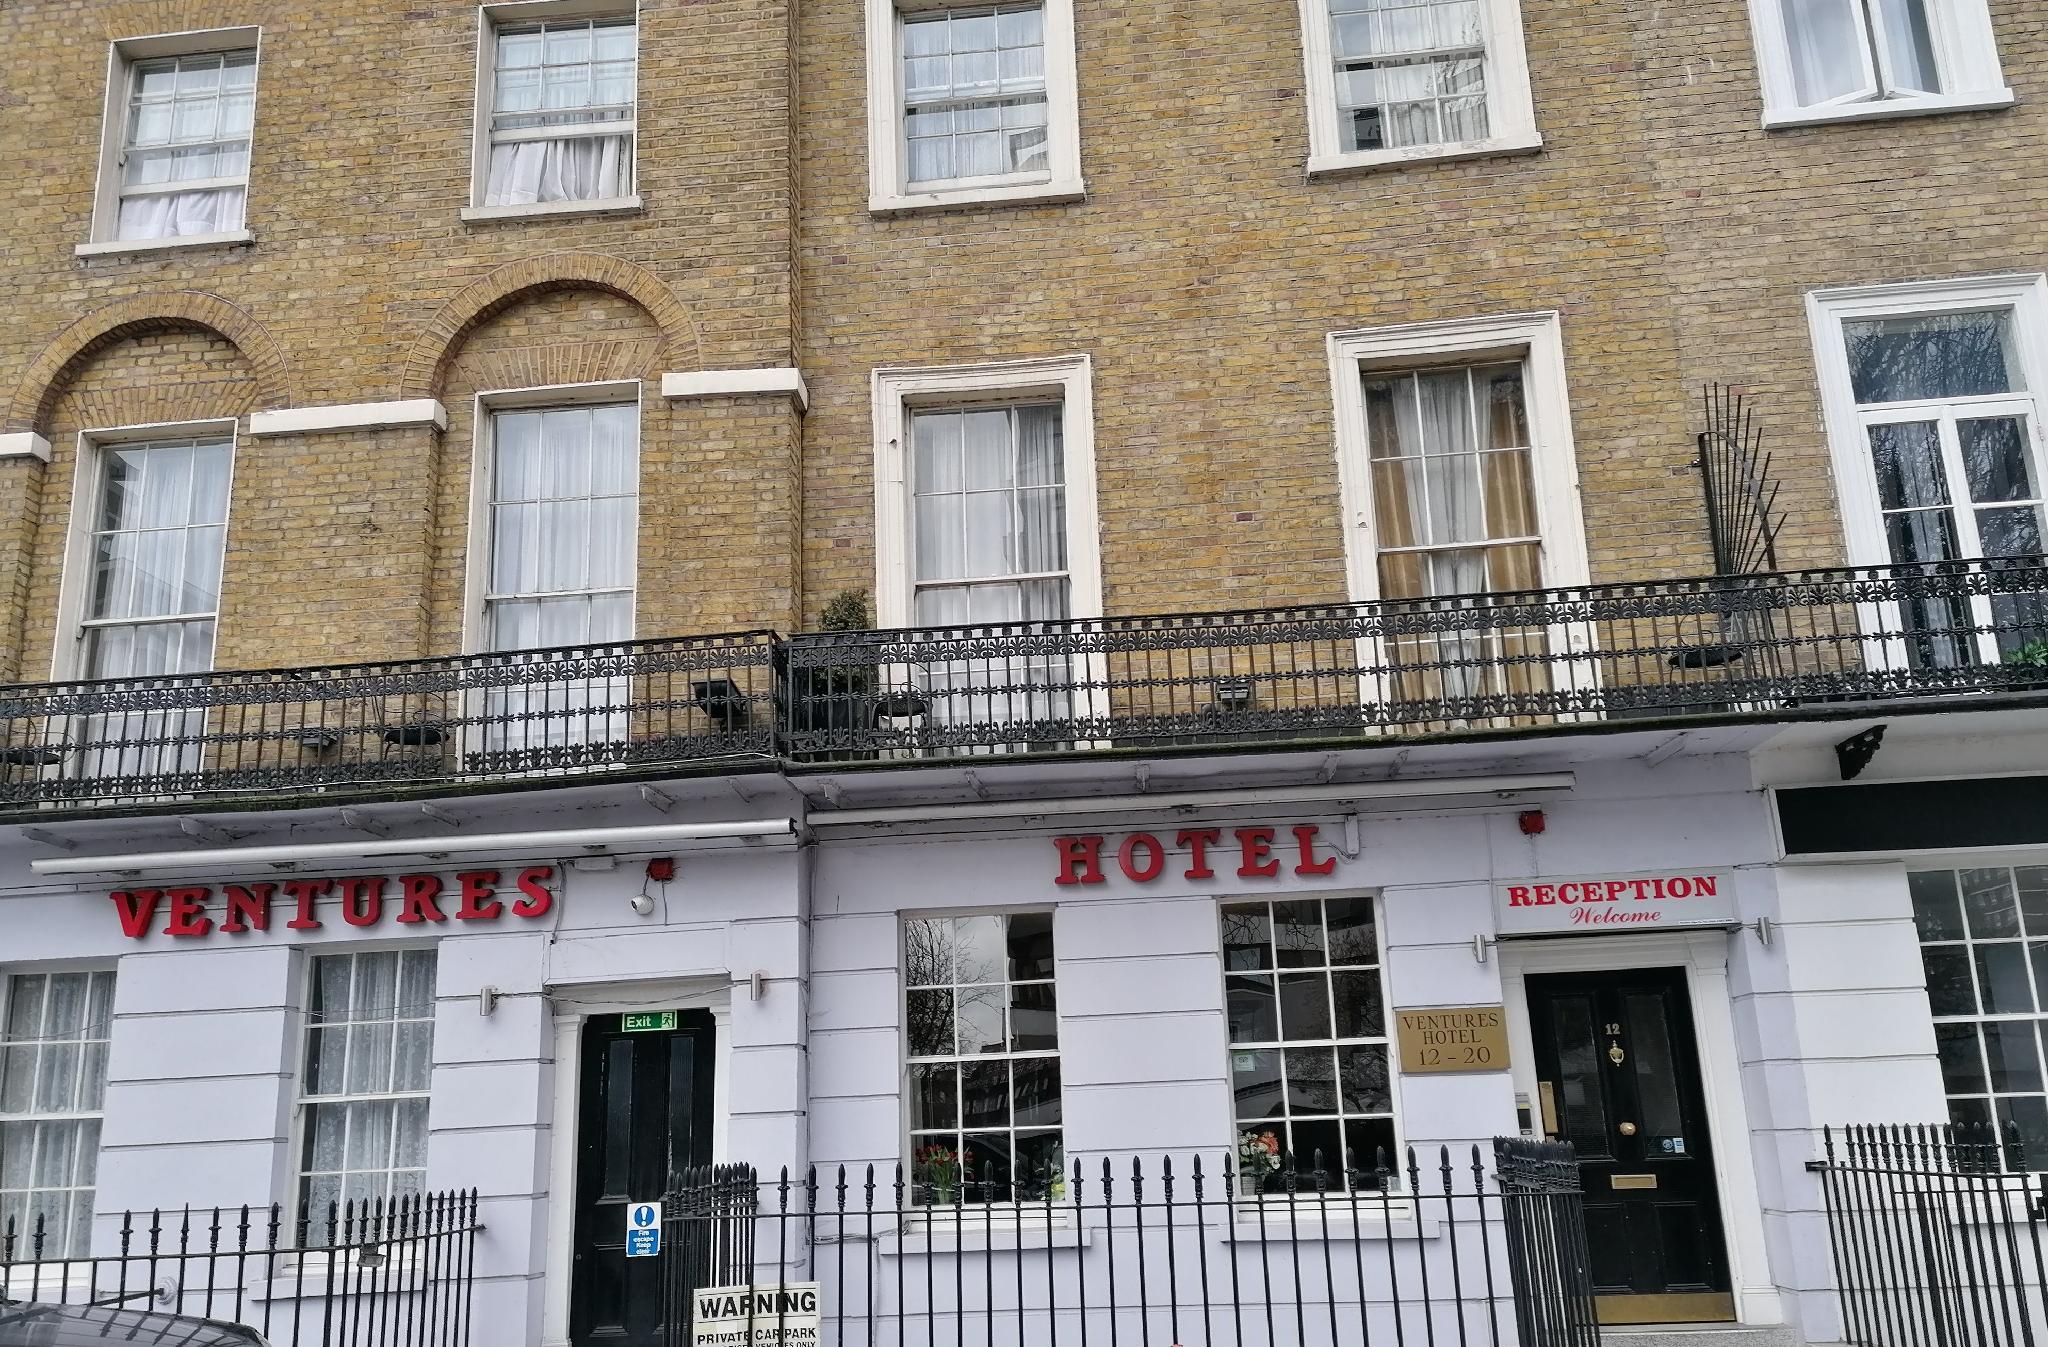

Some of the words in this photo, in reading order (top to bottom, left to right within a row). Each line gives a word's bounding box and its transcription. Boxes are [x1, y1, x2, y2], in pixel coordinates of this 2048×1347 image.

[1053, 826, 1337, 885] HOTEL
[1507, 876, 1717, 907] RECEPTION
[109, 867, 553, 937] VENTURES
[1569, 906, 1662, 925] Welcome
[626, 1015, 652, 1028] Exit
[1403, 1013, 1499, 1030] VENTURES
[1605, 1023, 1621, 1035] 12
[1423, 1029, 1482, 1045] HOTEL
[1420, 1048, 1441, 1066] 12
[1463, 1046, 1491, 1064] 20
[699, 1292, 816, 1319] WARNING
[697, 1331, 750, 1345] PRIVATE
[755, 1328, 780, 1340] CAR
[784, 1327, 817, 1339] PARK
